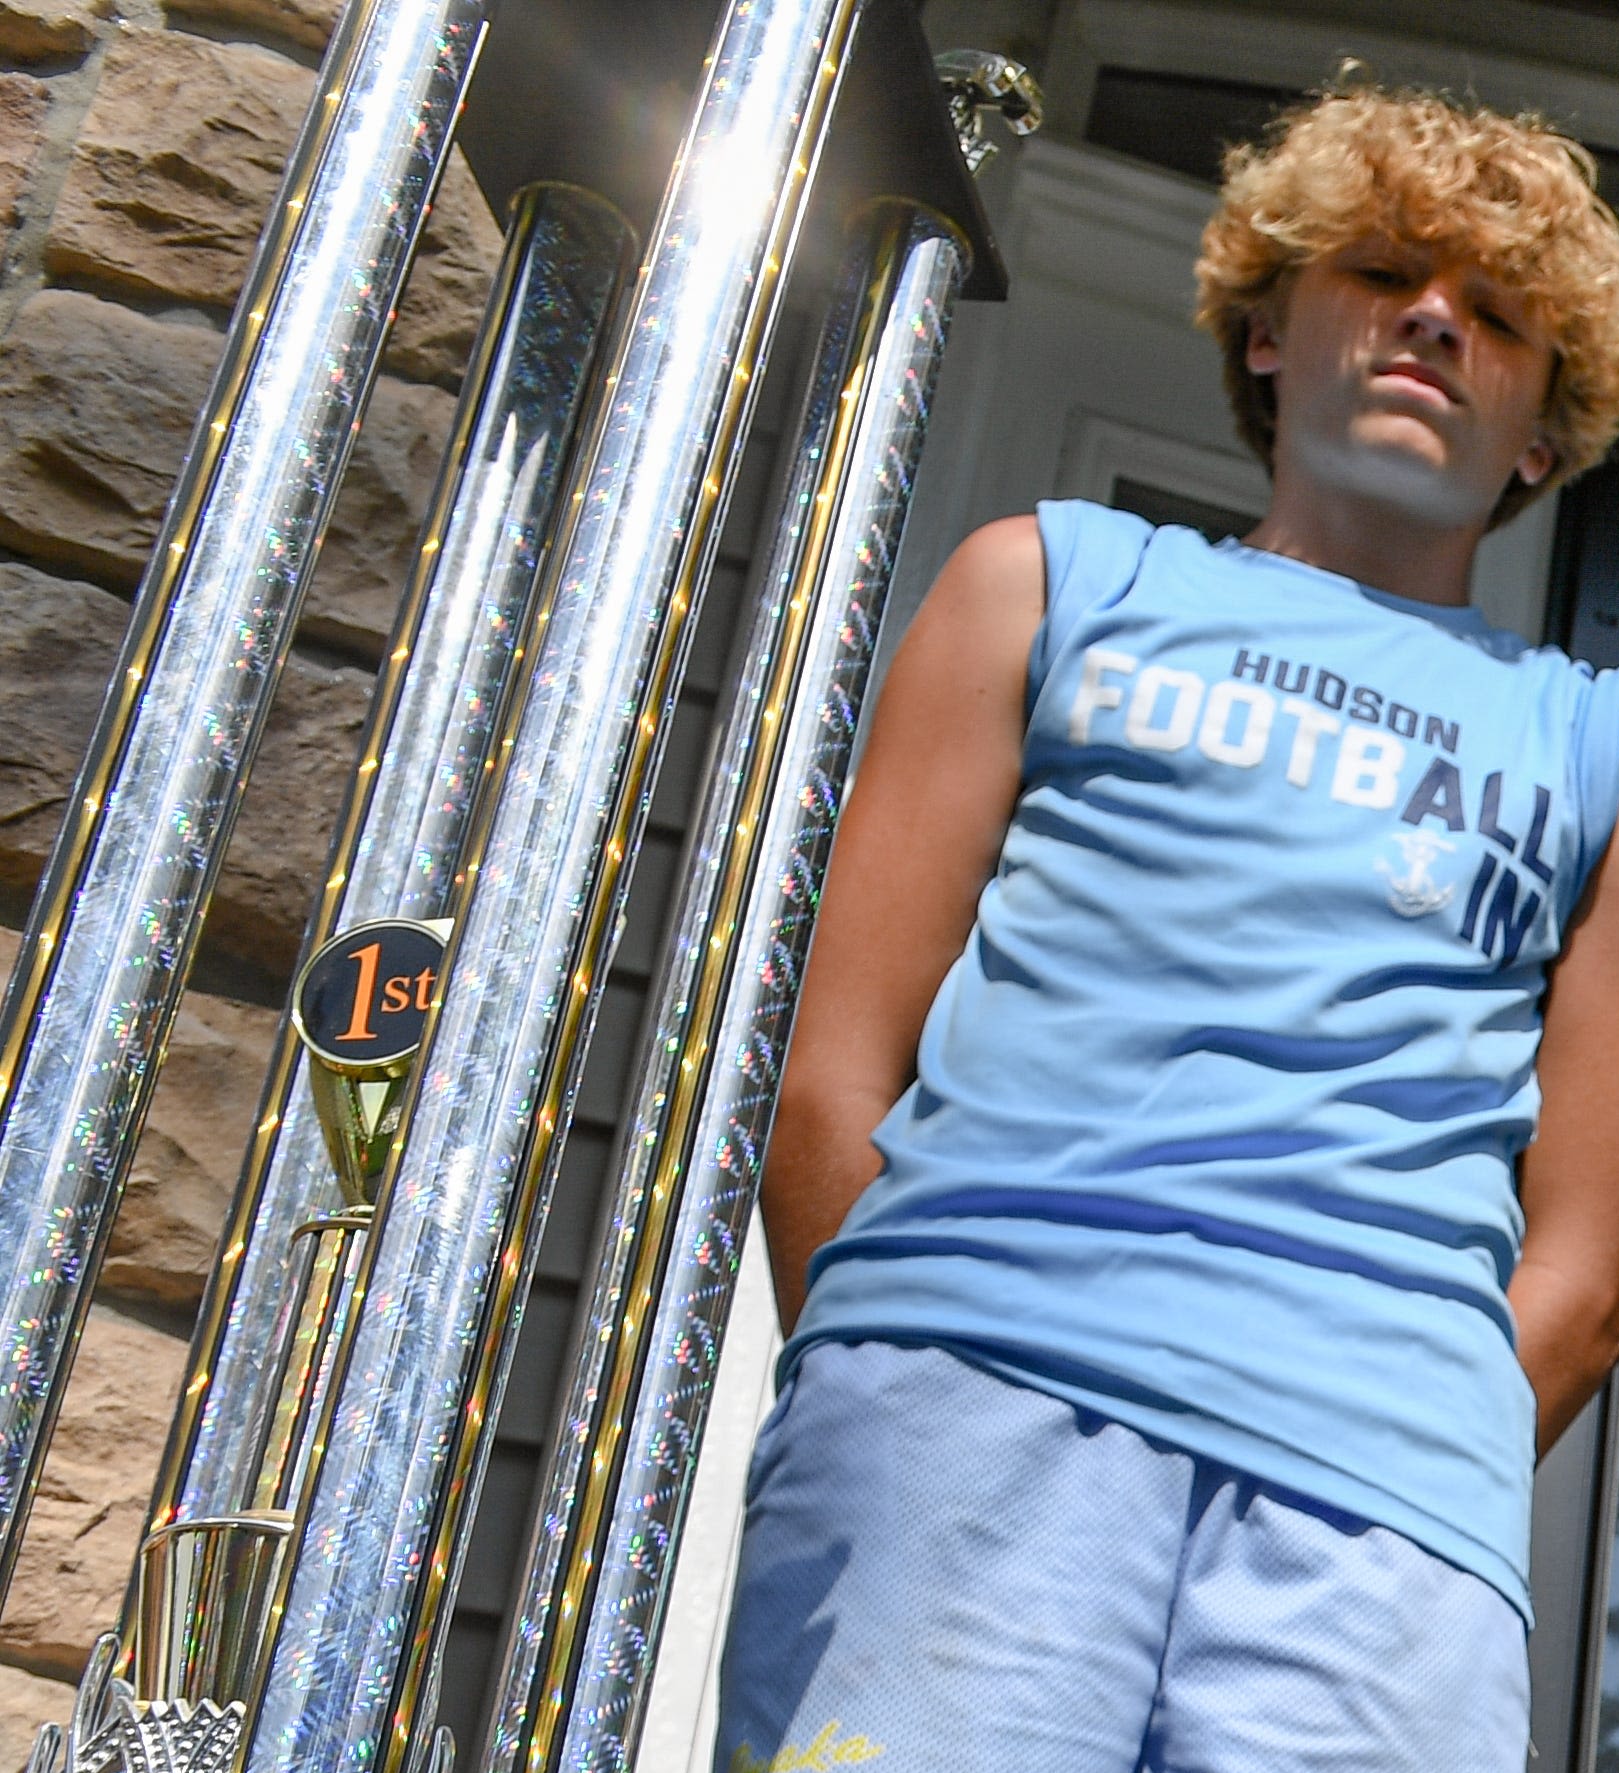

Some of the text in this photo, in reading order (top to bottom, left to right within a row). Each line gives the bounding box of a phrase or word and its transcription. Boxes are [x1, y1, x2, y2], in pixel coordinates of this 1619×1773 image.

[1232, 648, 1461, 754] HUDSON
[1067, 646, 1553, 885] FOOTBALL
[1460, 851, 1541, 964] IN
[335, 942, 438, 1041] 1st
